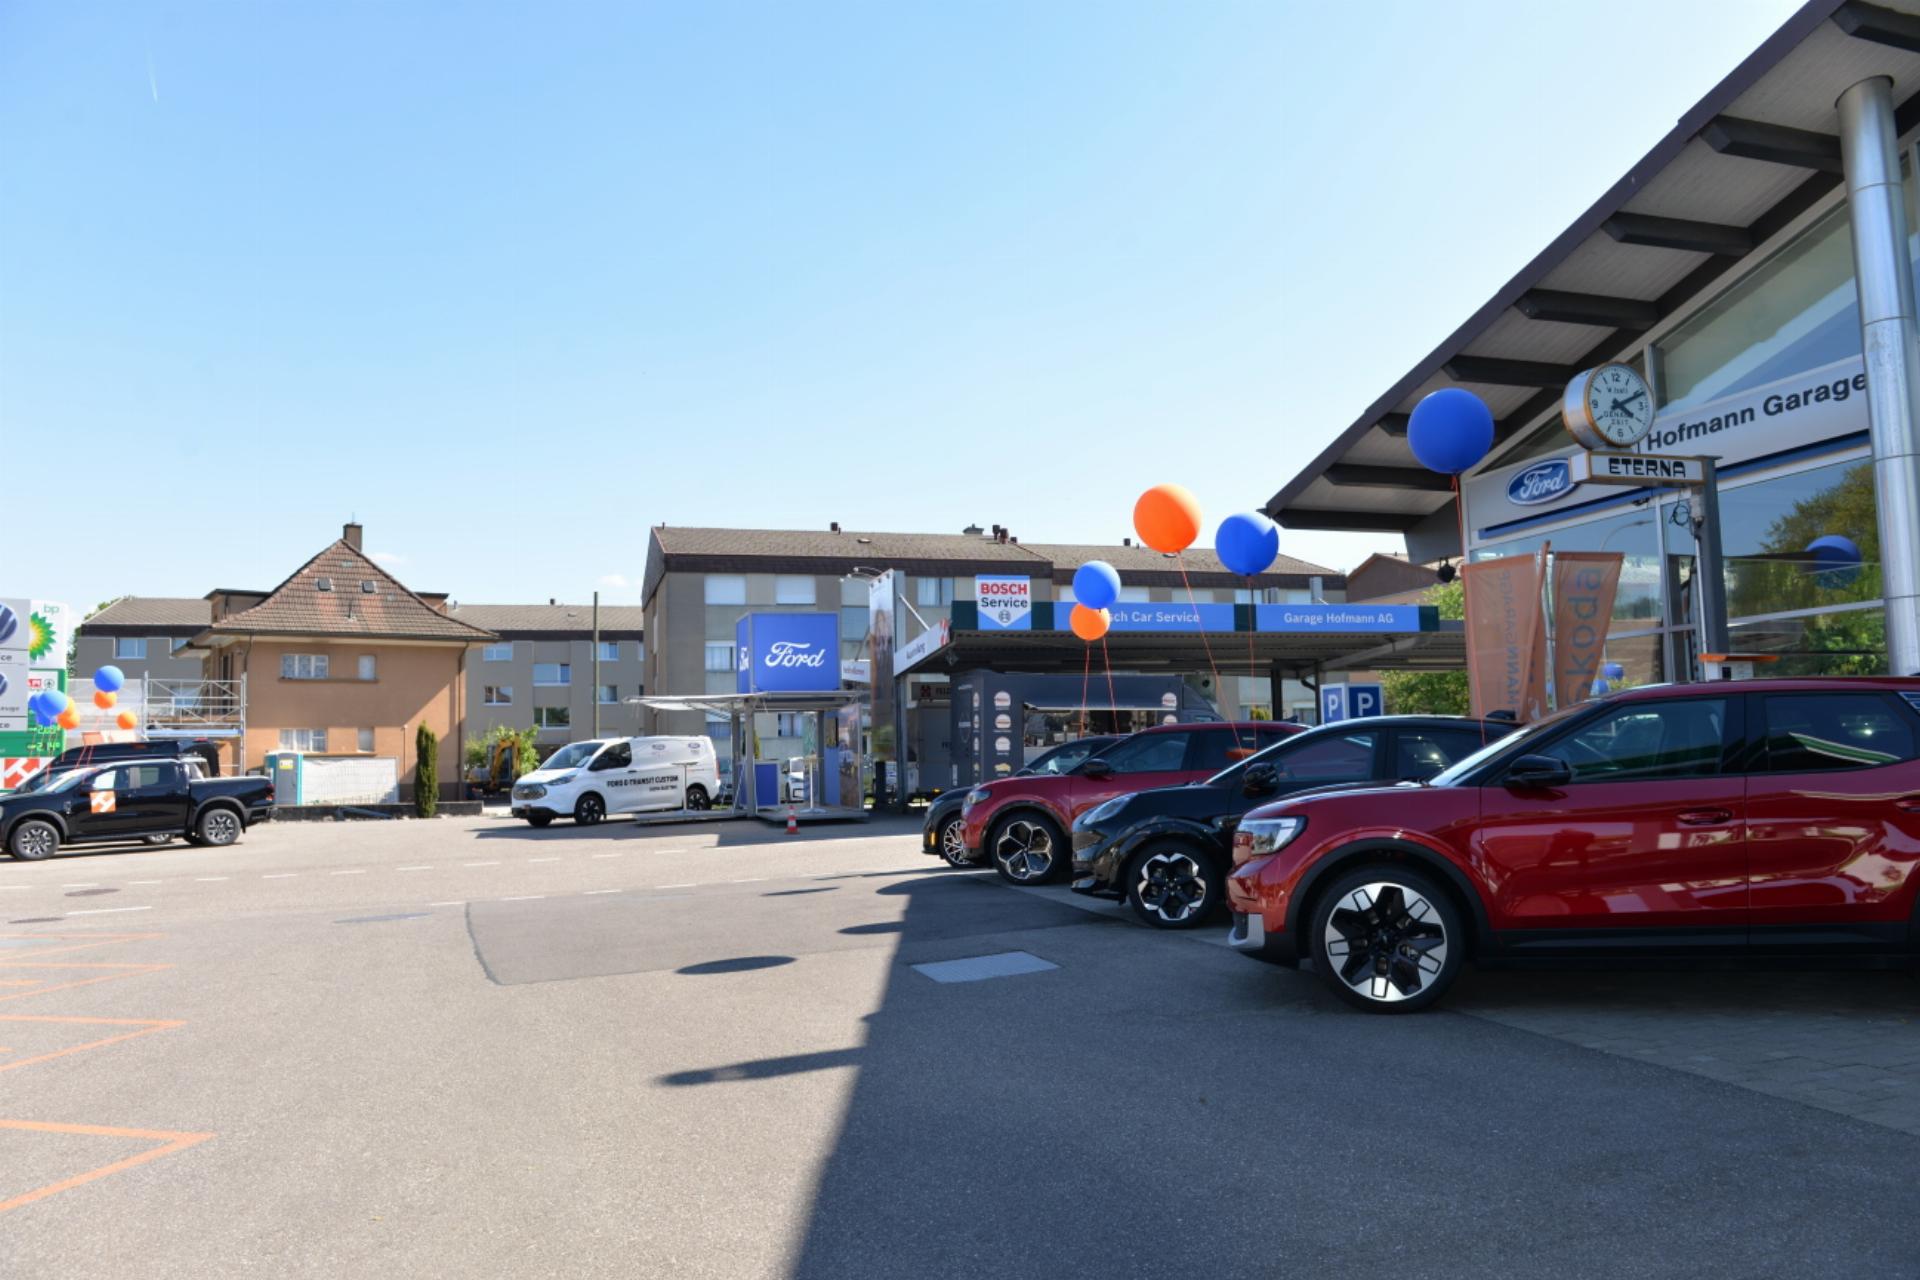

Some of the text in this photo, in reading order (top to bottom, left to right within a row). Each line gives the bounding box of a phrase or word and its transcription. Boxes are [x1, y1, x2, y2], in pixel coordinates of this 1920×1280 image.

[1611, 373, 1620, 382] 12
[1647, 373, 1868, 451] Hofmann Garage
[1608, 457, 1686, 478] ETERNA
[1519, 466, 1565, 499] Ford
[981, 583, 1028, 595] BOSCH
[44, 604, 60, 615] bp
[981, 597, 1028, 608] Service
[1132, 612, 1151, 623] Car
[1156, 611, 1200, 623] Service
[1284, 612, 1394, 625] Garage Hofmann AG
[765, 641, 827, 668] Ford
[1328, 694, 1338, 718] P
[1357, 692, 1374, 716] P
